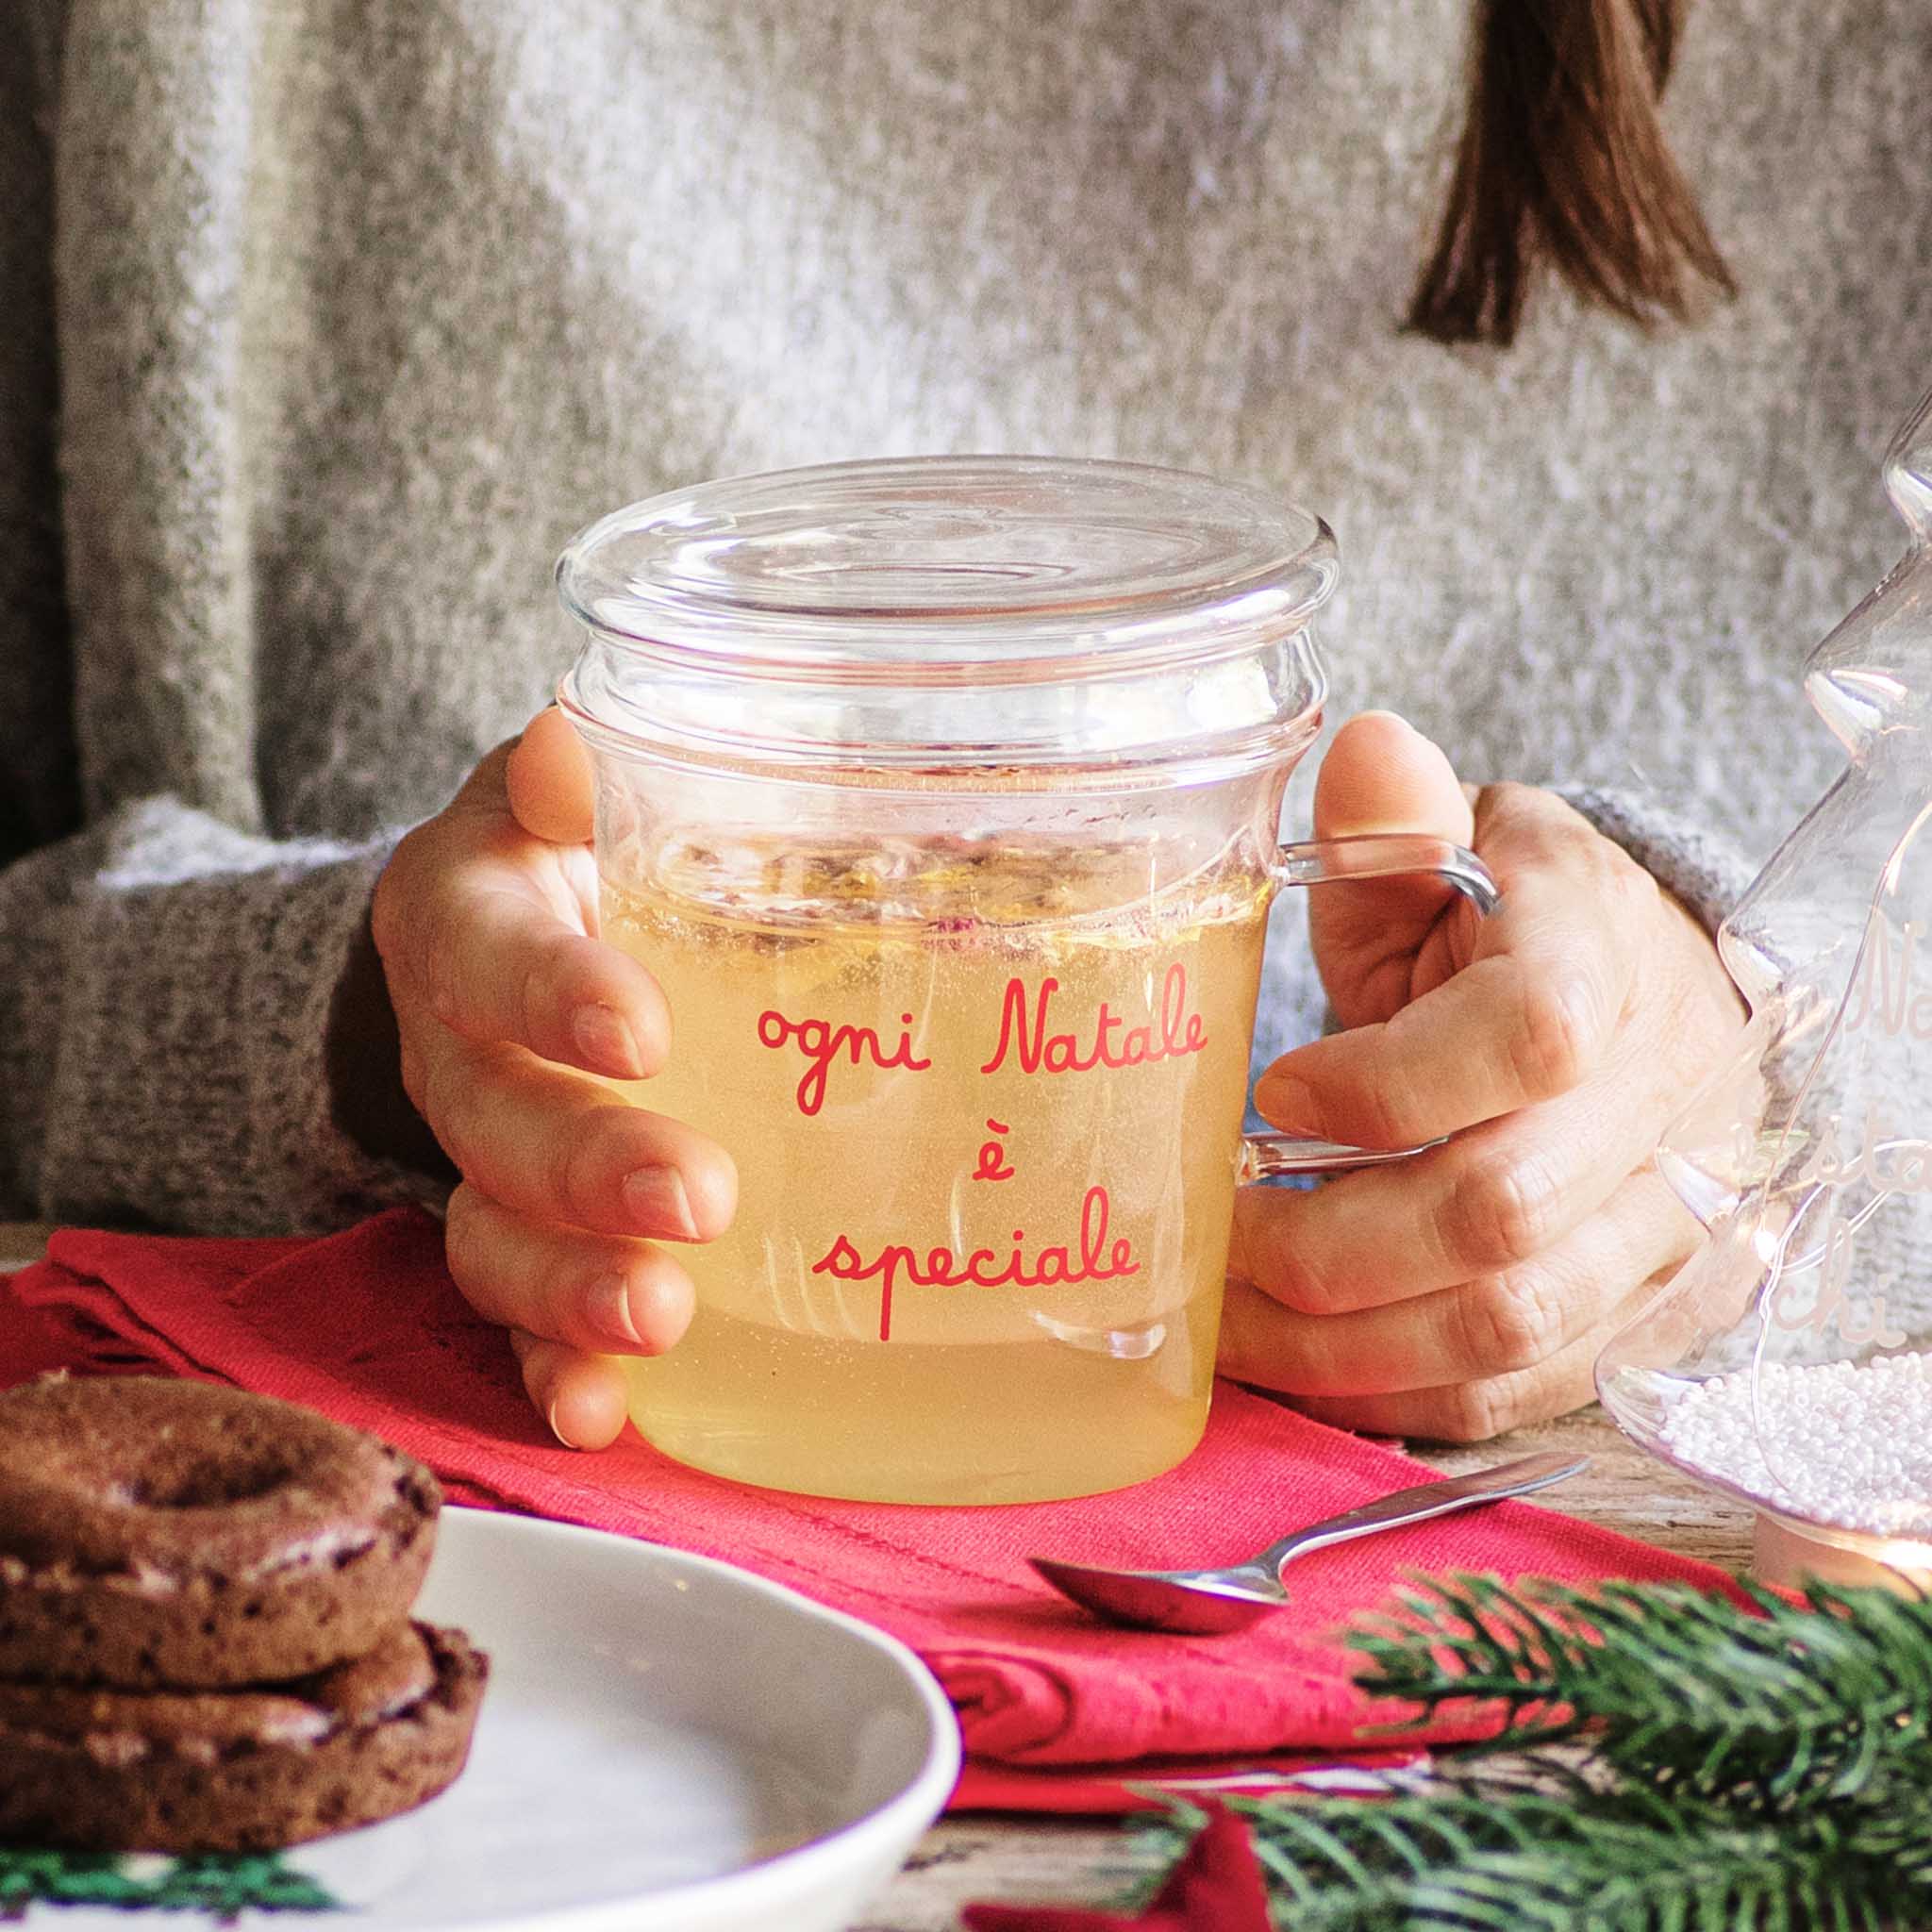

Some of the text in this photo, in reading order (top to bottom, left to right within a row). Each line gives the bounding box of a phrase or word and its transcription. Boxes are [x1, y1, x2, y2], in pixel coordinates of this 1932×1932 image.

[757, 963, 1208, 1117] ogni Natale
[972, 1117, 1016, 1182] è
[811, 1185, 1142, 1342] speciale
